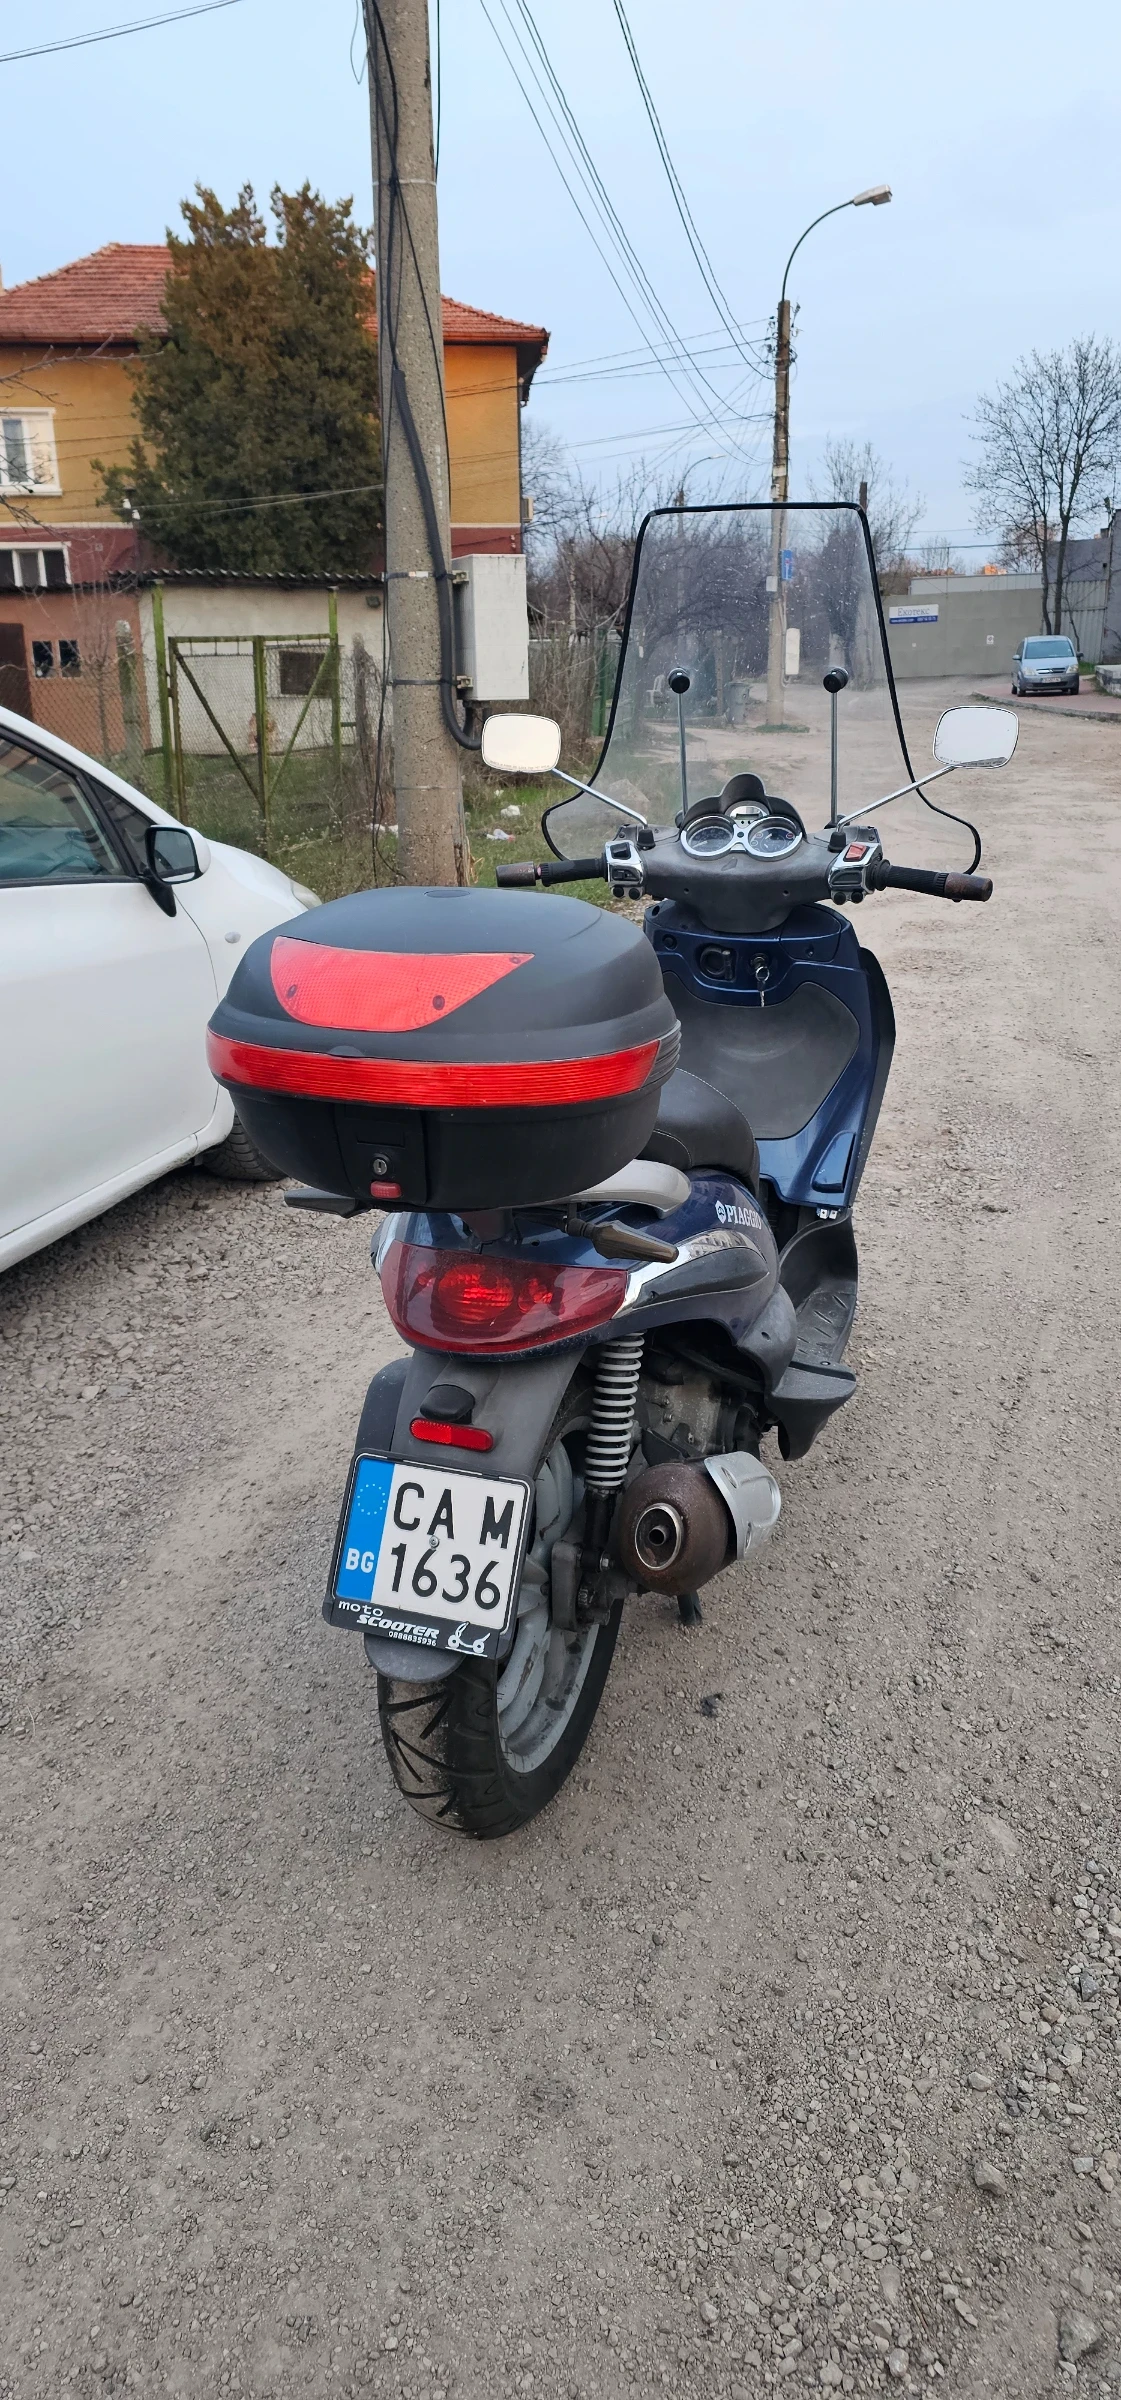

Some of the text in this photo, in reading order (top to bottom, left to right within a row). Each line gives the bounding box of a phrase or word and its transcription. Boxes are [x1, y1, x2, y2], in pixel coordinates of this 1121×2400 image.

[725, 1204, 762, 1230] PIAGGIO
[393, 1481, 515, 1550] CA M
[345, 1547, 375, 1573] BG
[391, 1542, 501, 1610] 1636
[338, 1600, 384, 1617] moto
[356, 1613, 440, 1640] SCOOTER
